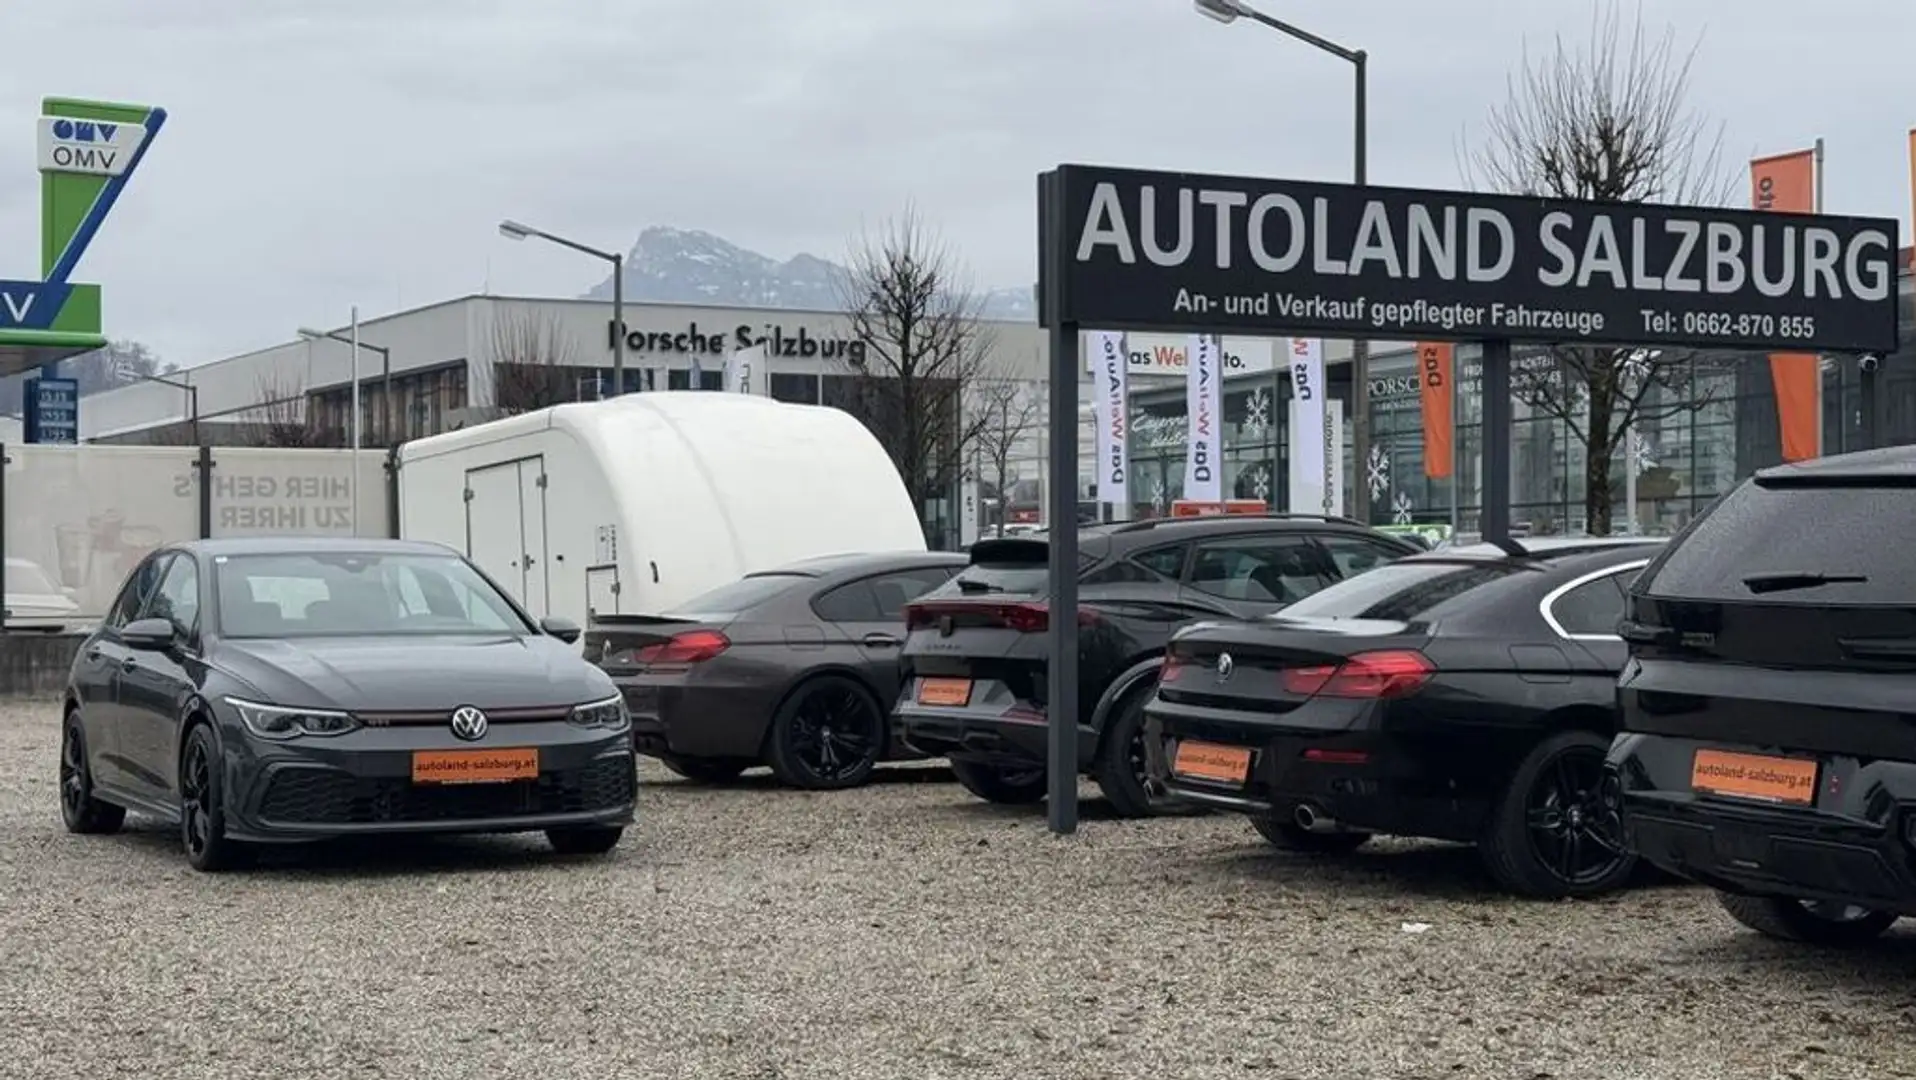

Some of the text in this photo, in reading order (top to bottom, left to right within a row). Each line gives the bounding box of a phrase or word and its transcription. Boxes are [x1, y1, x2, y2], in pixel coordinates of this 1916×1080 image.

[53, 146, 116, 169] OMV
[1076, 181, 1889, 301] AUTOLAND SALZBURG
[1174, 288, 1815, 339] An- und Verkauf gepflegter Fahrzeuge Tel: 0662-870 855
[608, 320, 727, 354] Porsche
[1129, 345, 1246, 369] as Welto.
[1367, 375, 1420, 397] PORSC
[415, 757, 537, 774] autoland-salzburg.at
[1695, 763, 1812, 788] autoland-salzburg.at
